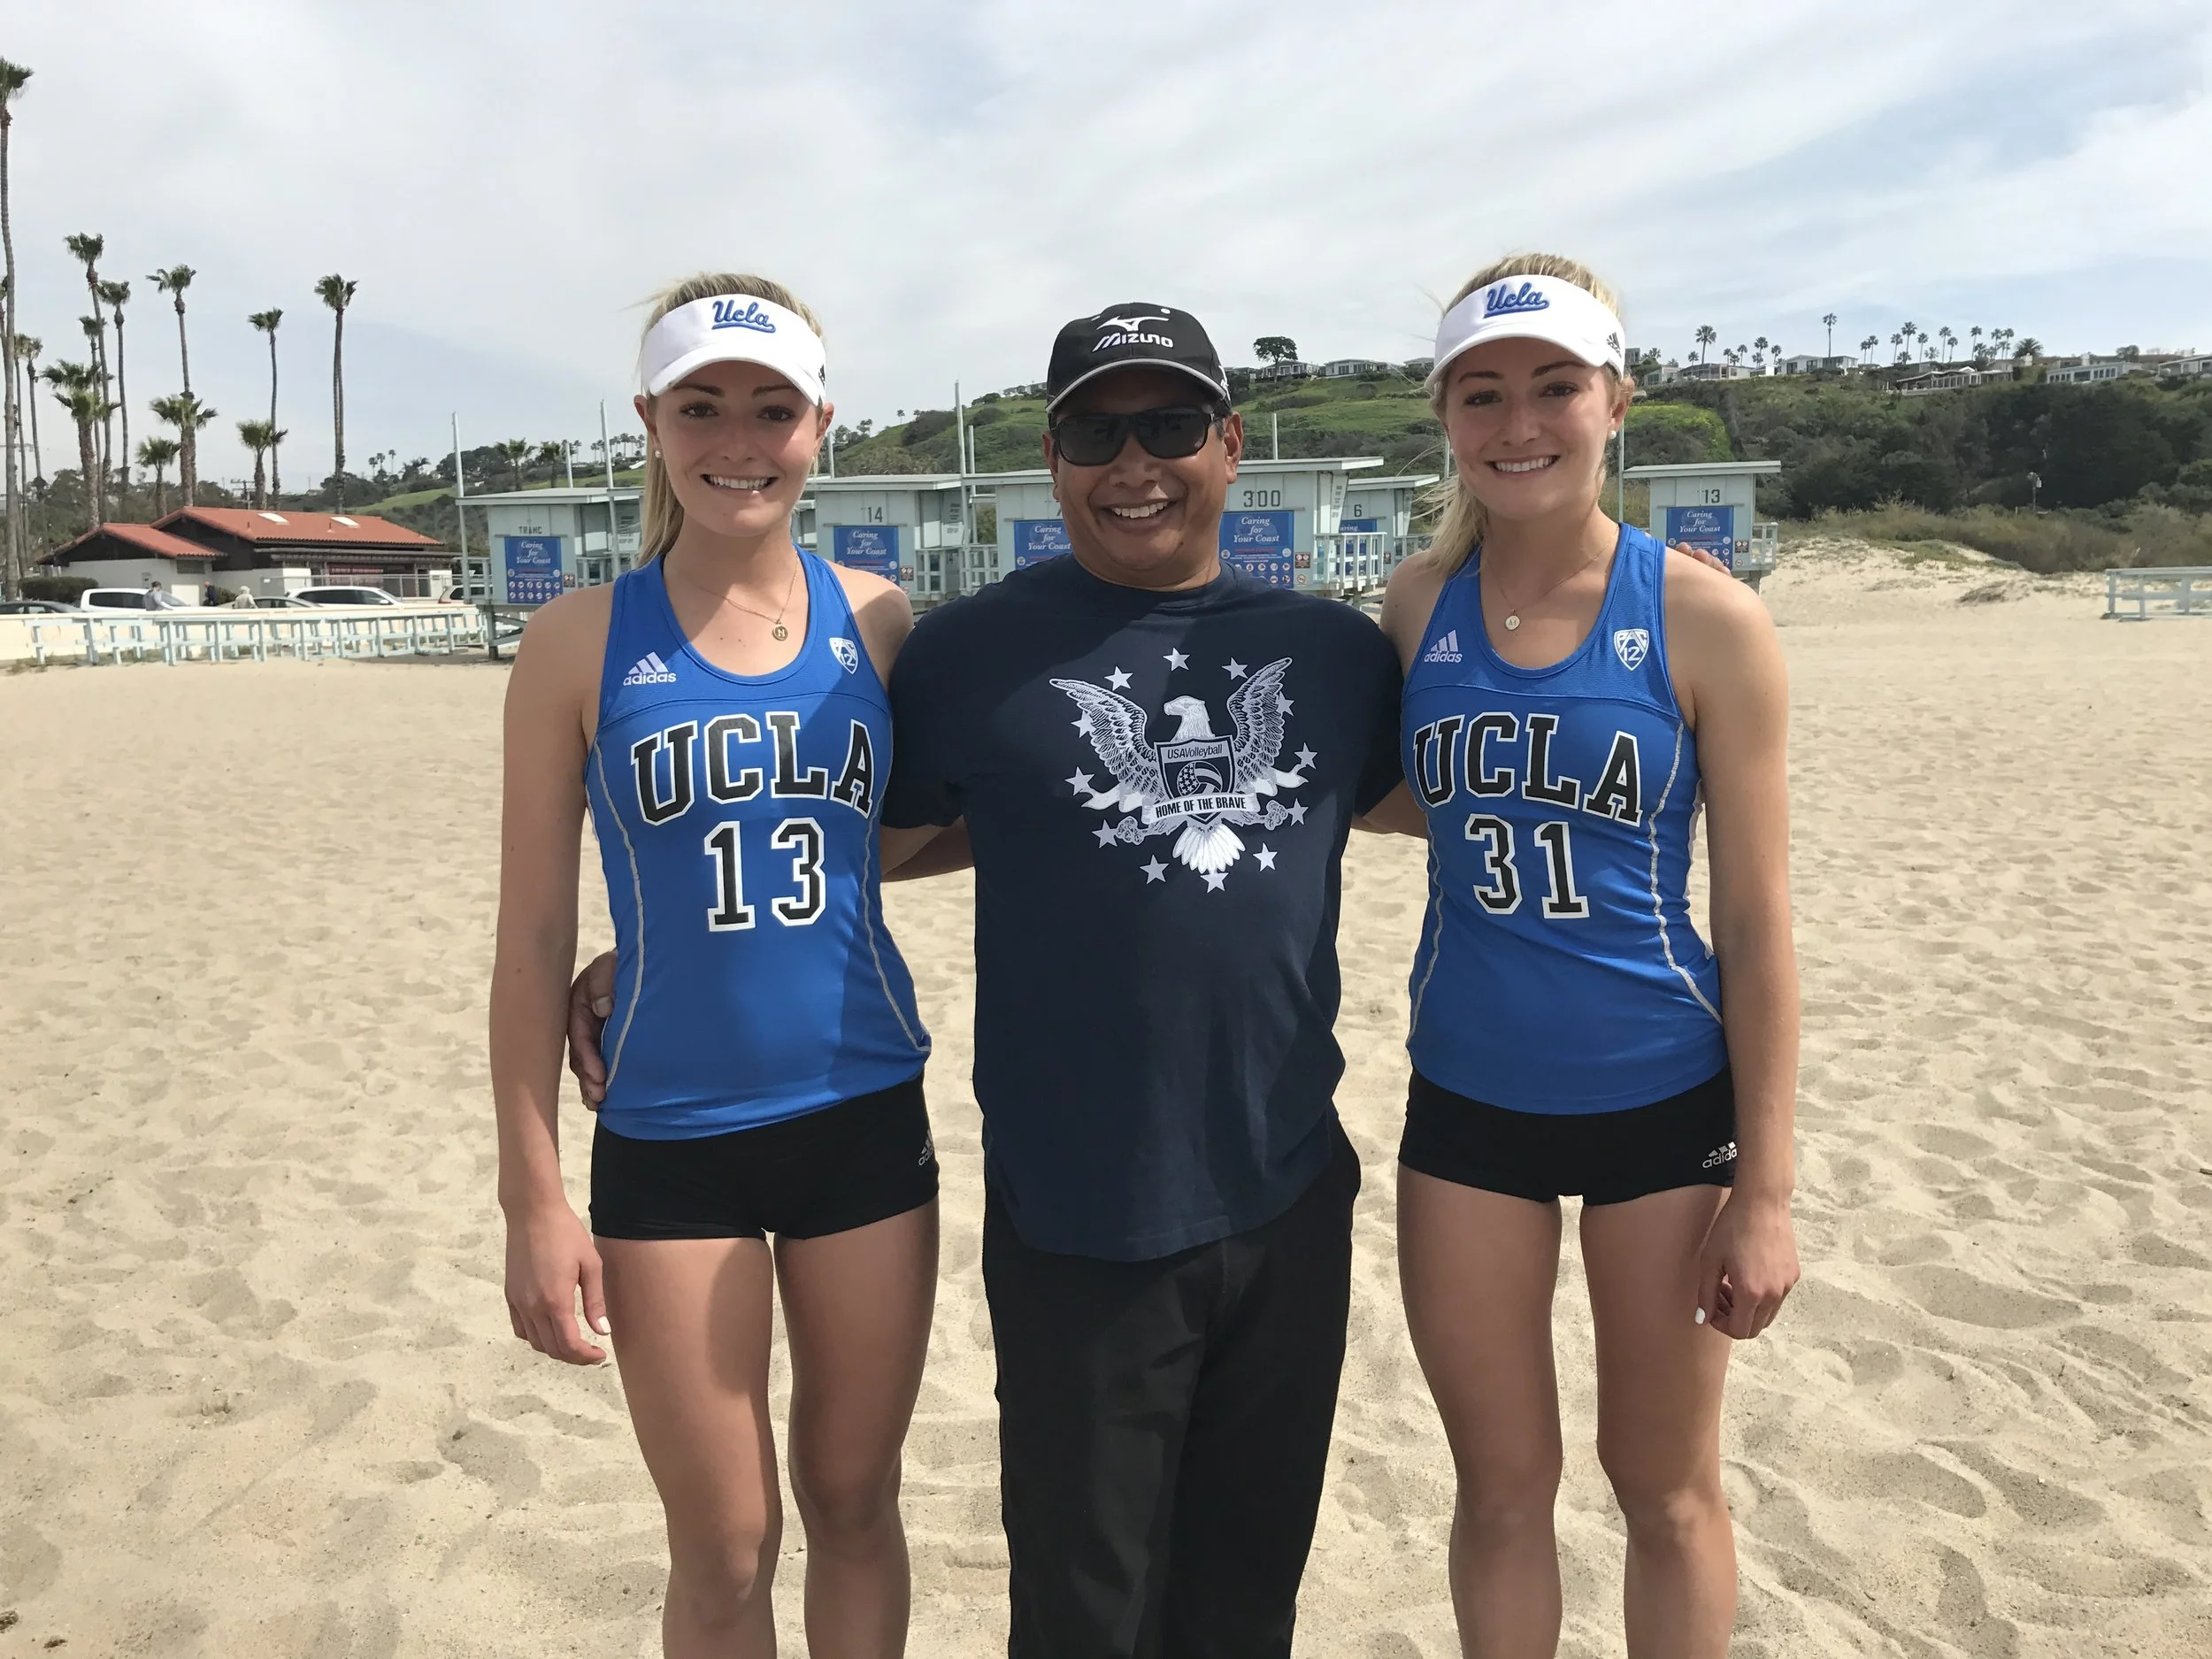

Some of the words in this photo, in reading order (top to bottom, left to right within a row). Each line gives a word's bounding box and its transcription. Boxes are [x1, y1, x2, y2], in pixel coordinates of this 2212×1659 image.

[1483, 281, 1550, 319] Ucla
[711, 299, 776, 334] Ucla
[1243, 489, 1280, 508] 300
[1704, 488, 1720, 504] 13
[868, 506, 883, 523] 14
[1354, 503, 1363, 518] 6
[1686, 511, 1713, 519] Caring
[1241, 517, 1271, 526] Caring
[1340, 523, 1358, 532] aring
[1694, 518, 1707, 527] for
[852, 530, 879, 540] Caring
[1034, 525, 1062, 535] Caring
[1248, 526, 1263, 536] for
[521, 540, 544, 550] Caring
[859, 538, 872, 549] for
[1027, 541, 1047, 550] Your
[1048, 541, 1071, 550] Coast
[1041, 534, 1056, 544] for
[1233, 534, 1254, 543] Your
[527, 548, 539, 558] for
[846, 546, 864, 555] Your
[865, 547, 887, 556] Coast
[841, 652, 856, 667] 12
[1424, 649, 1463, 664] adidas
[1624, 646, 1641, 662] 12
[623, 670, 677, 687] adidas
[1167, 744, 1223, 759] USAVolleyball
[631, 711, 875, 826] UCLA
[1413, 711, 1643, 828] UCLA
[1156, 801, 1182, 818] HOME
[1183, 799, 1194, 812] OF
[1197, 797, 1214, 810] THE
[1216, 796, 1247, 810] BRAVE
[1464, 813, 1590, 919] 31
[703, 817, 826, 932] 13
[1701, 1148, 1738, 1169] adida
